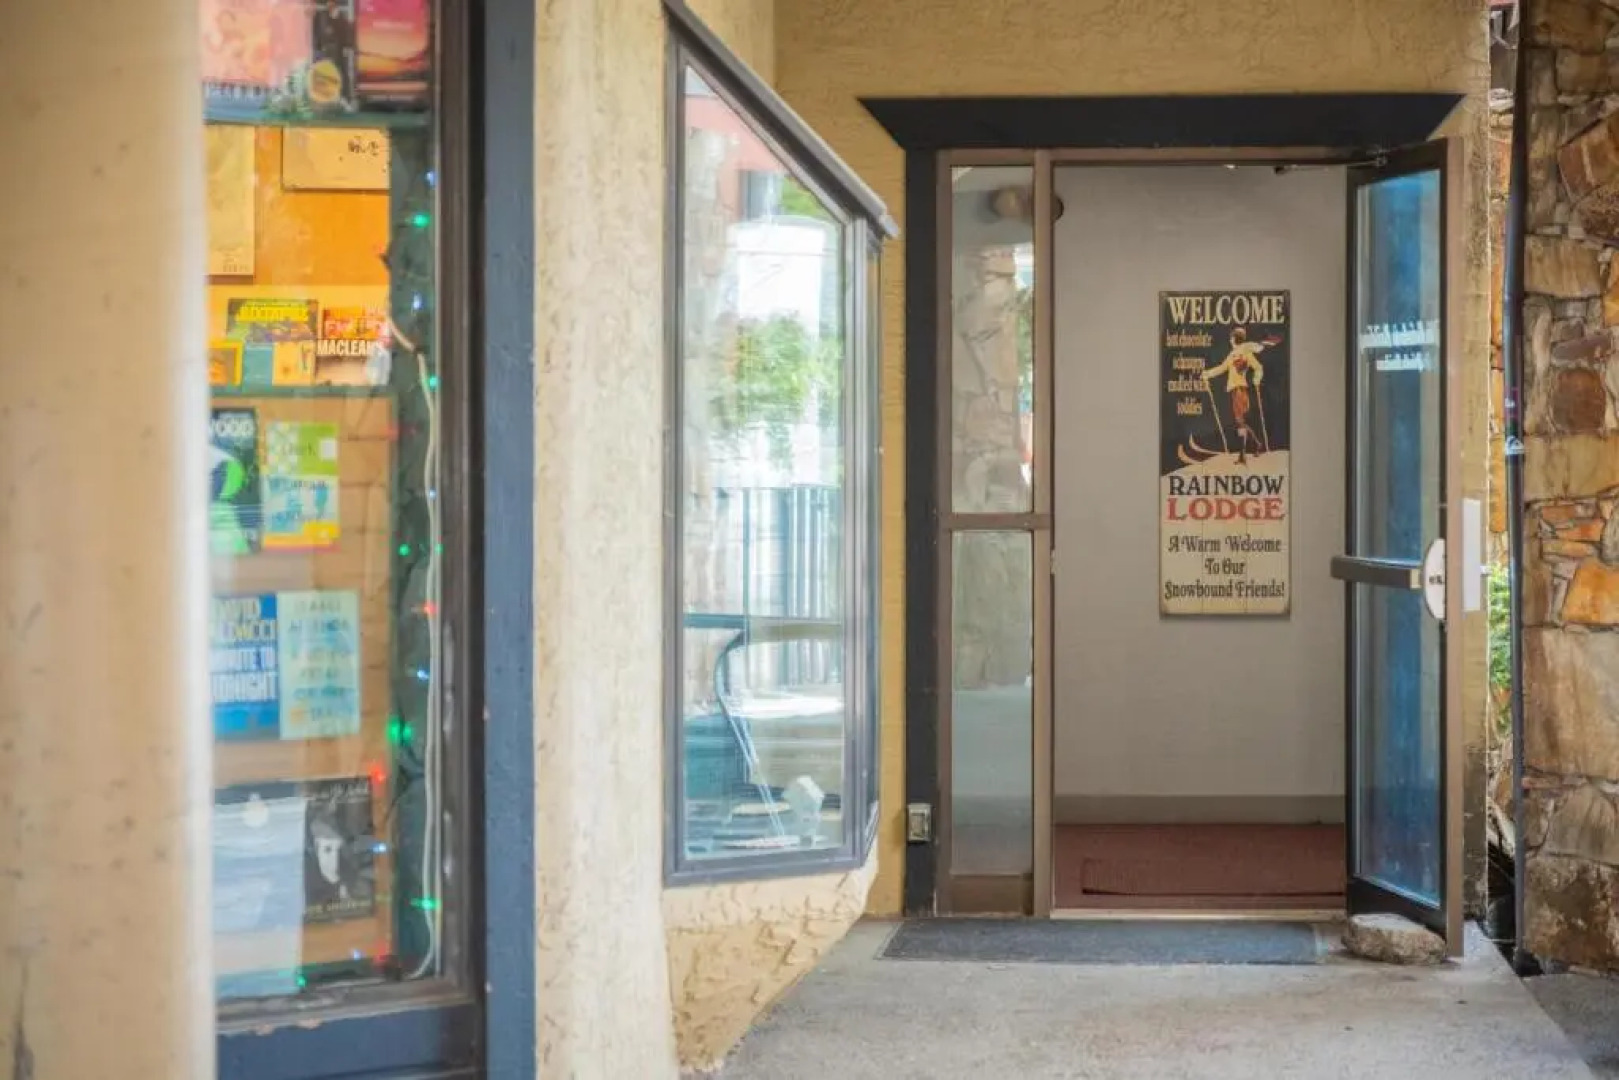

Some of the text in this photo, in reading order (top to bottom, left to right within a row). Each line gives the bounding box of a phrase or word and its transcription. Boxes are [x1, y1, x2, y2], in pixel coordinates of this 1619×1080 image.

[1167, 294, 1285, 324] WELCOME
[1169, 475, 1285, 496] RAINBOW
[1167, 497, 1286, 520] LODGE
[1168, 533, 1282, 553] A Warm Welcome
[1204, 556, 1246, 575] To Our
[1165, 578, 1285, 600] Snowbound Friends!
